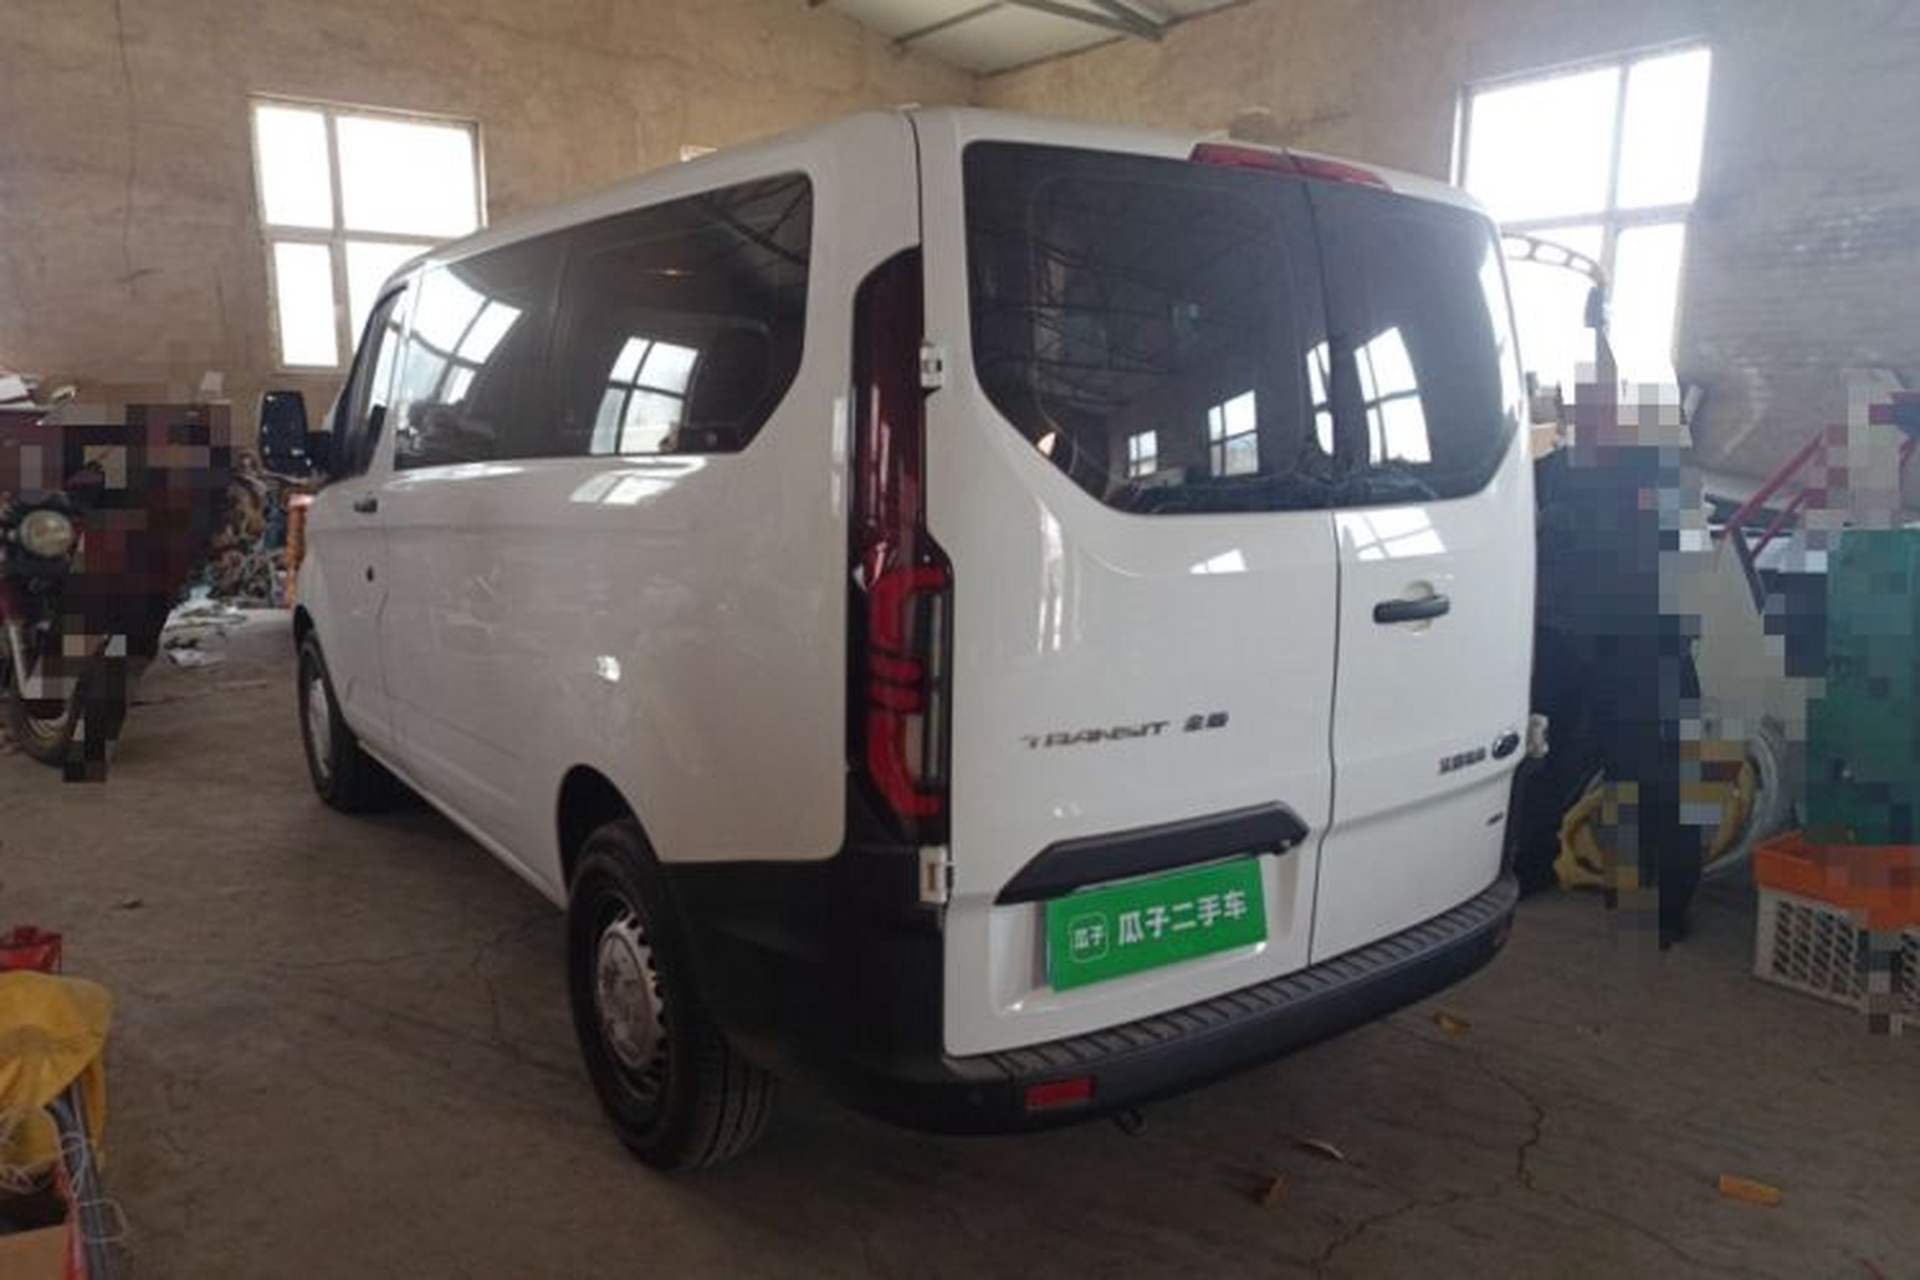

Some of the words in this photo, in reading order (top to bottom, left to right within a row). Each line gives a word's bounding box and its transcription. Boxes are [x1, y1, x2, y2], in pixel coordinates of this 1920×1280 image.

[1021, 720, 1170, 750] TRANSIT
[1117, 889, 1248, 947] 瓜子二手车
